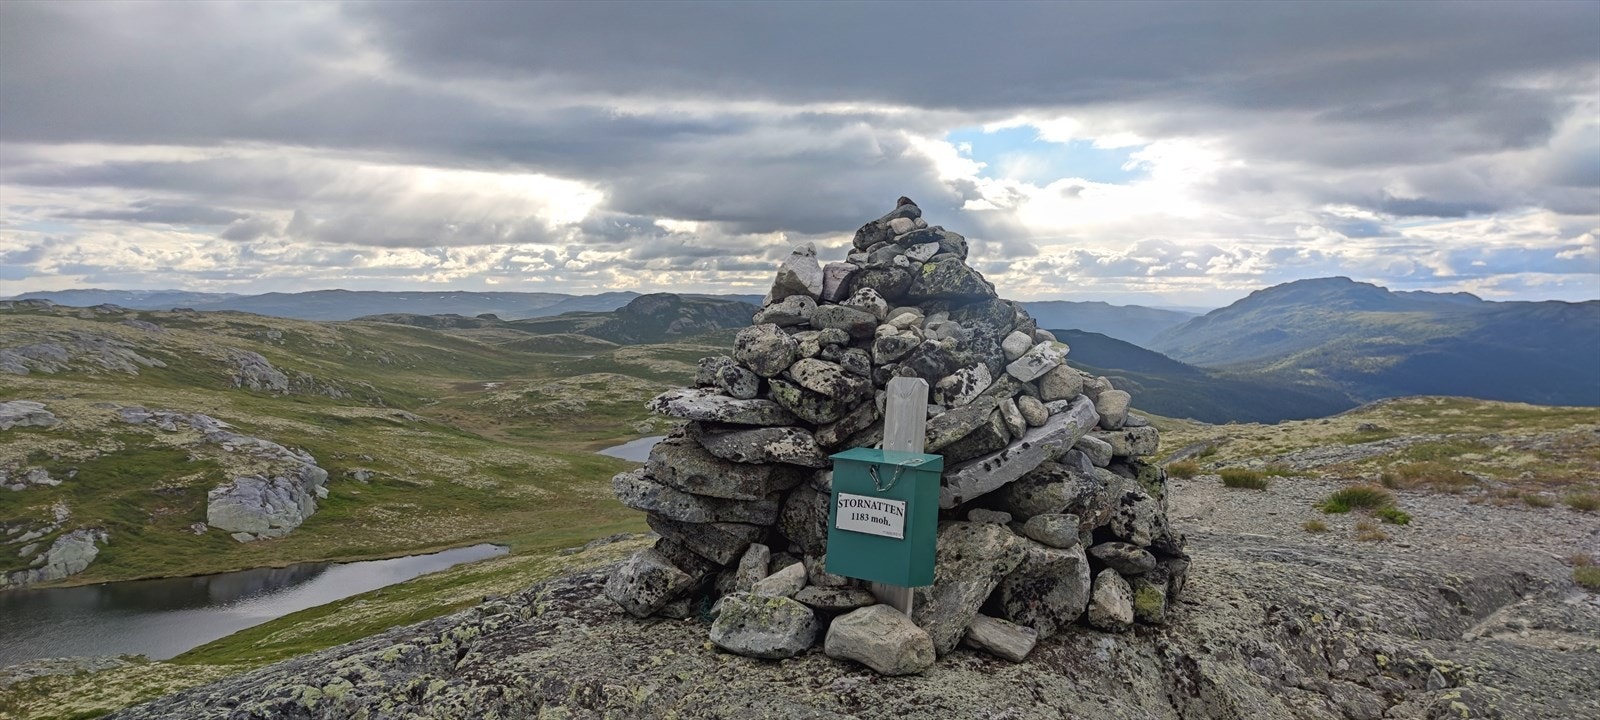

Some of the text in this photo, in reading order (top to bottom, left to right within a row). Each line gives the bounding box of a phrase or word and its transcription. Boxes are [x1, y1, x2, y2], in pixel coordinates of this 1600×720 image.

[838, 498, 904, 517] STORNATTEN
[851, 512, 891, 526] 1183 moh.
